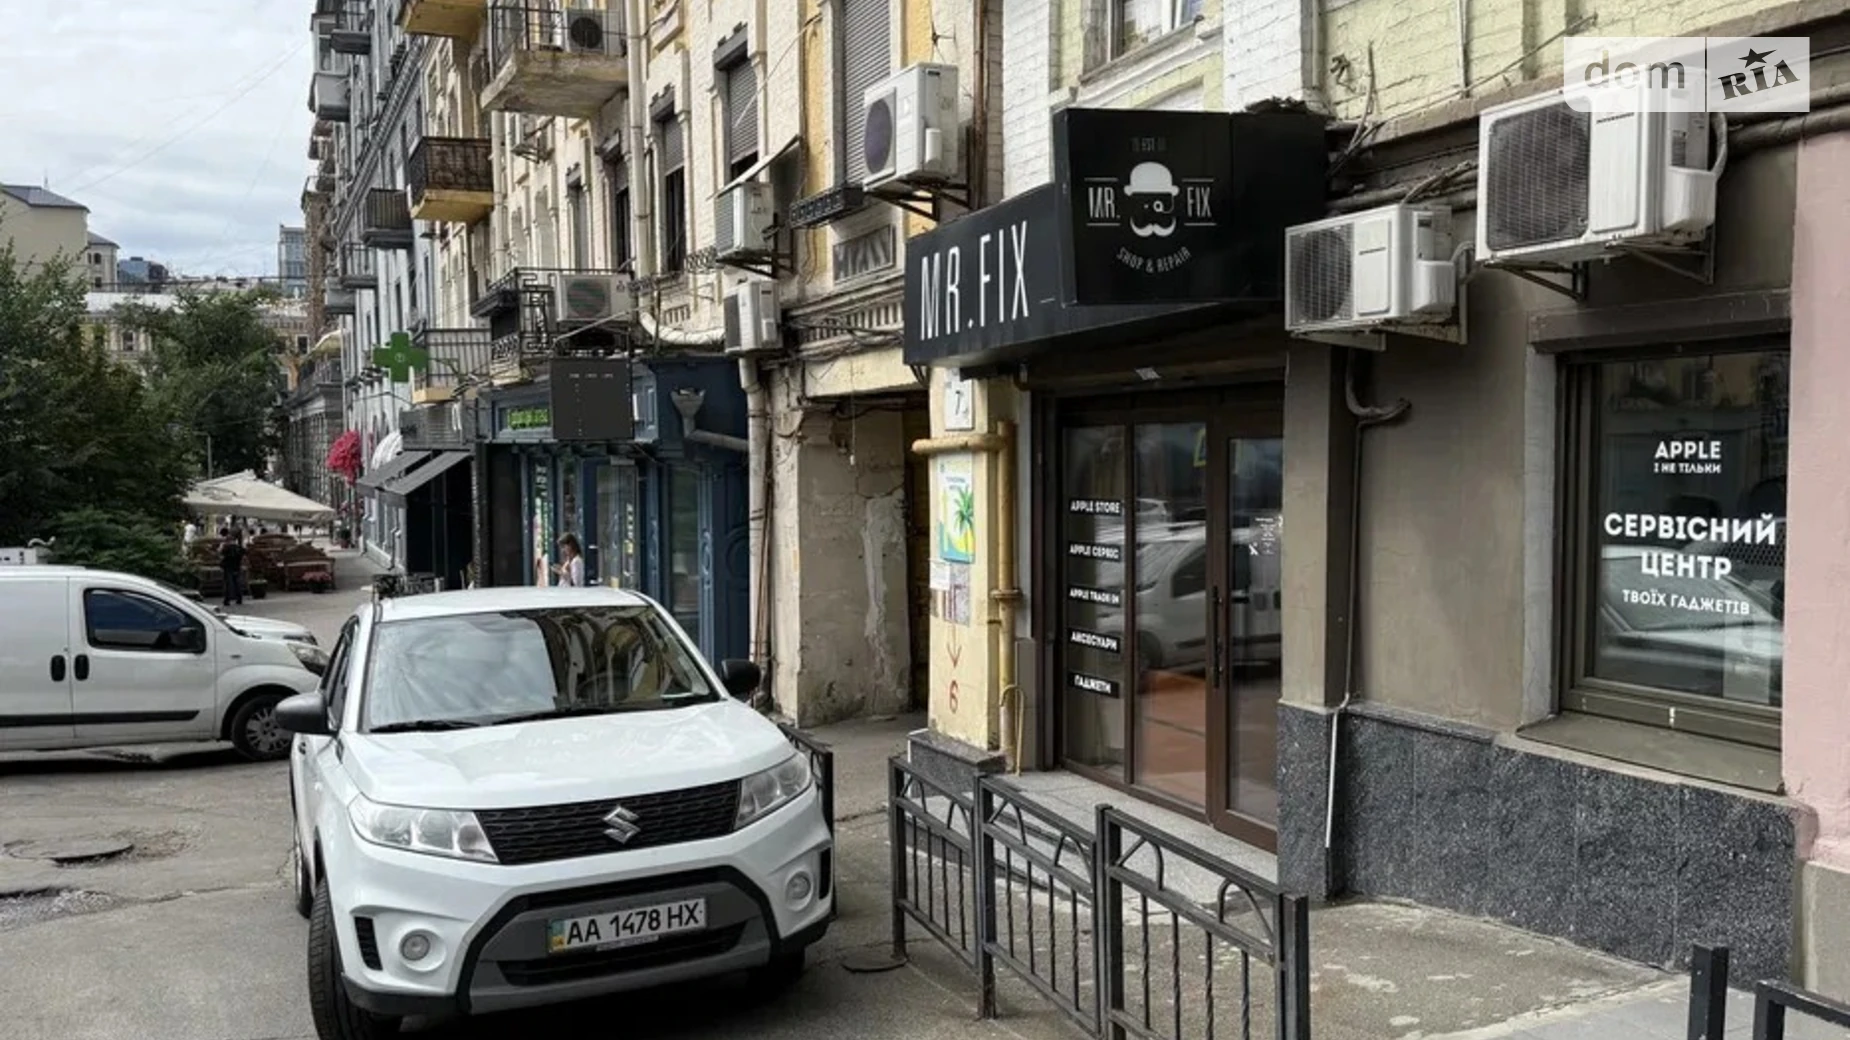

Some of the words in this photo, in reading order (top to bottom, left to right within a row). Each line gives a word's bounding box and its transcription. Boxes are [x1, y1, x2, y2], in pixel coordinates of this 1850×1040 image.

[1187, 187, 1212, 218] FIX
[1116, 246, 1144, 270] SHOP
[1145, 259, 1154, 273] &
[1156, 246, 1192, 272] REPAIR
[1655, 441, 1722, 460] APPLE
[1661, 463, 1676, 474] НЕ
[1679, 463, 1722, 475] ТІЛЬКИ
[1070, 500, 1094, 513] APPLE
[1095, 501, 1121, 514] STORE
[1604, 512, 1776, 545] СЕРВІСНИЙ
[1641, 551, 1732, 580] ЦЕНТР
[1622, 588, 1667, 607] ТВОЇХ
[1671, 595, 1750, 615] ГАДЖЕТІВ
[566, 919, 601, 945] AA
[609, 908, 661, 938] 1478
[667, 902, 699, 929] HX
